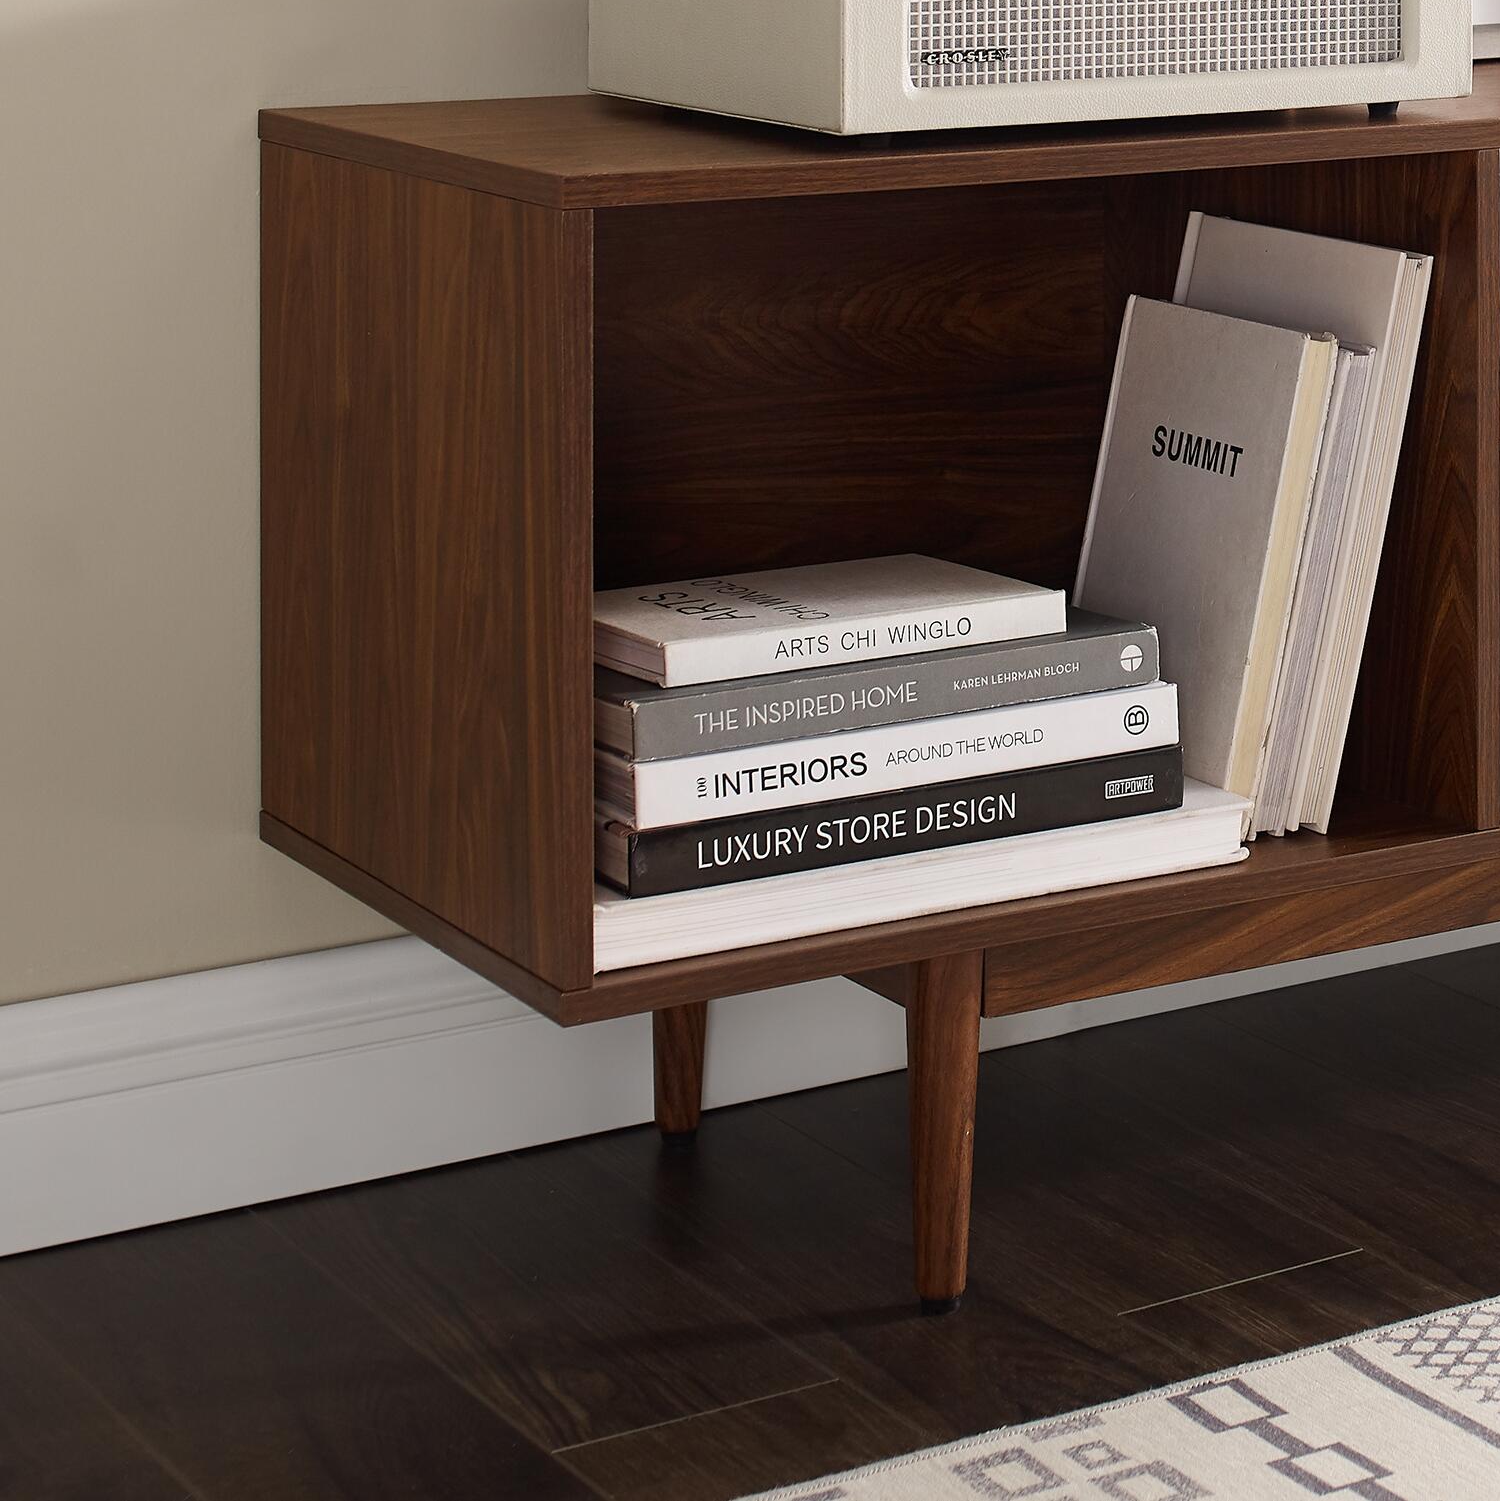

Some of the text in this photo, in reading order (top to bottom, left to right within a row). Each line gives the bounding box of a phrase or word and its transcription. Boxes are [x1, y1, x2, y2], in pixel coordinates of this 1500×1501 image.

[925, 49, 1011, 66] CROSLEY
[1151, 425, 1244, 478] SUMMIT
[638, 591, 756, 621] ARTS
[774, 616, 972, 660] ARTS CHI WINGLO
[953, 661, 1080, 691] KAREN LEHRMAN BLOCH
[693, 680, 919, 735] THE INSPIRED HOME
[885, 728, 1044, 767] AROUND THE WORLD
[696, 751, 869, 799] 100 INTERIORS
[1107, 776, 1154, 798] ARTPOWER
[697, 792, 1017, 869] LUXURY STORE DESIGN
